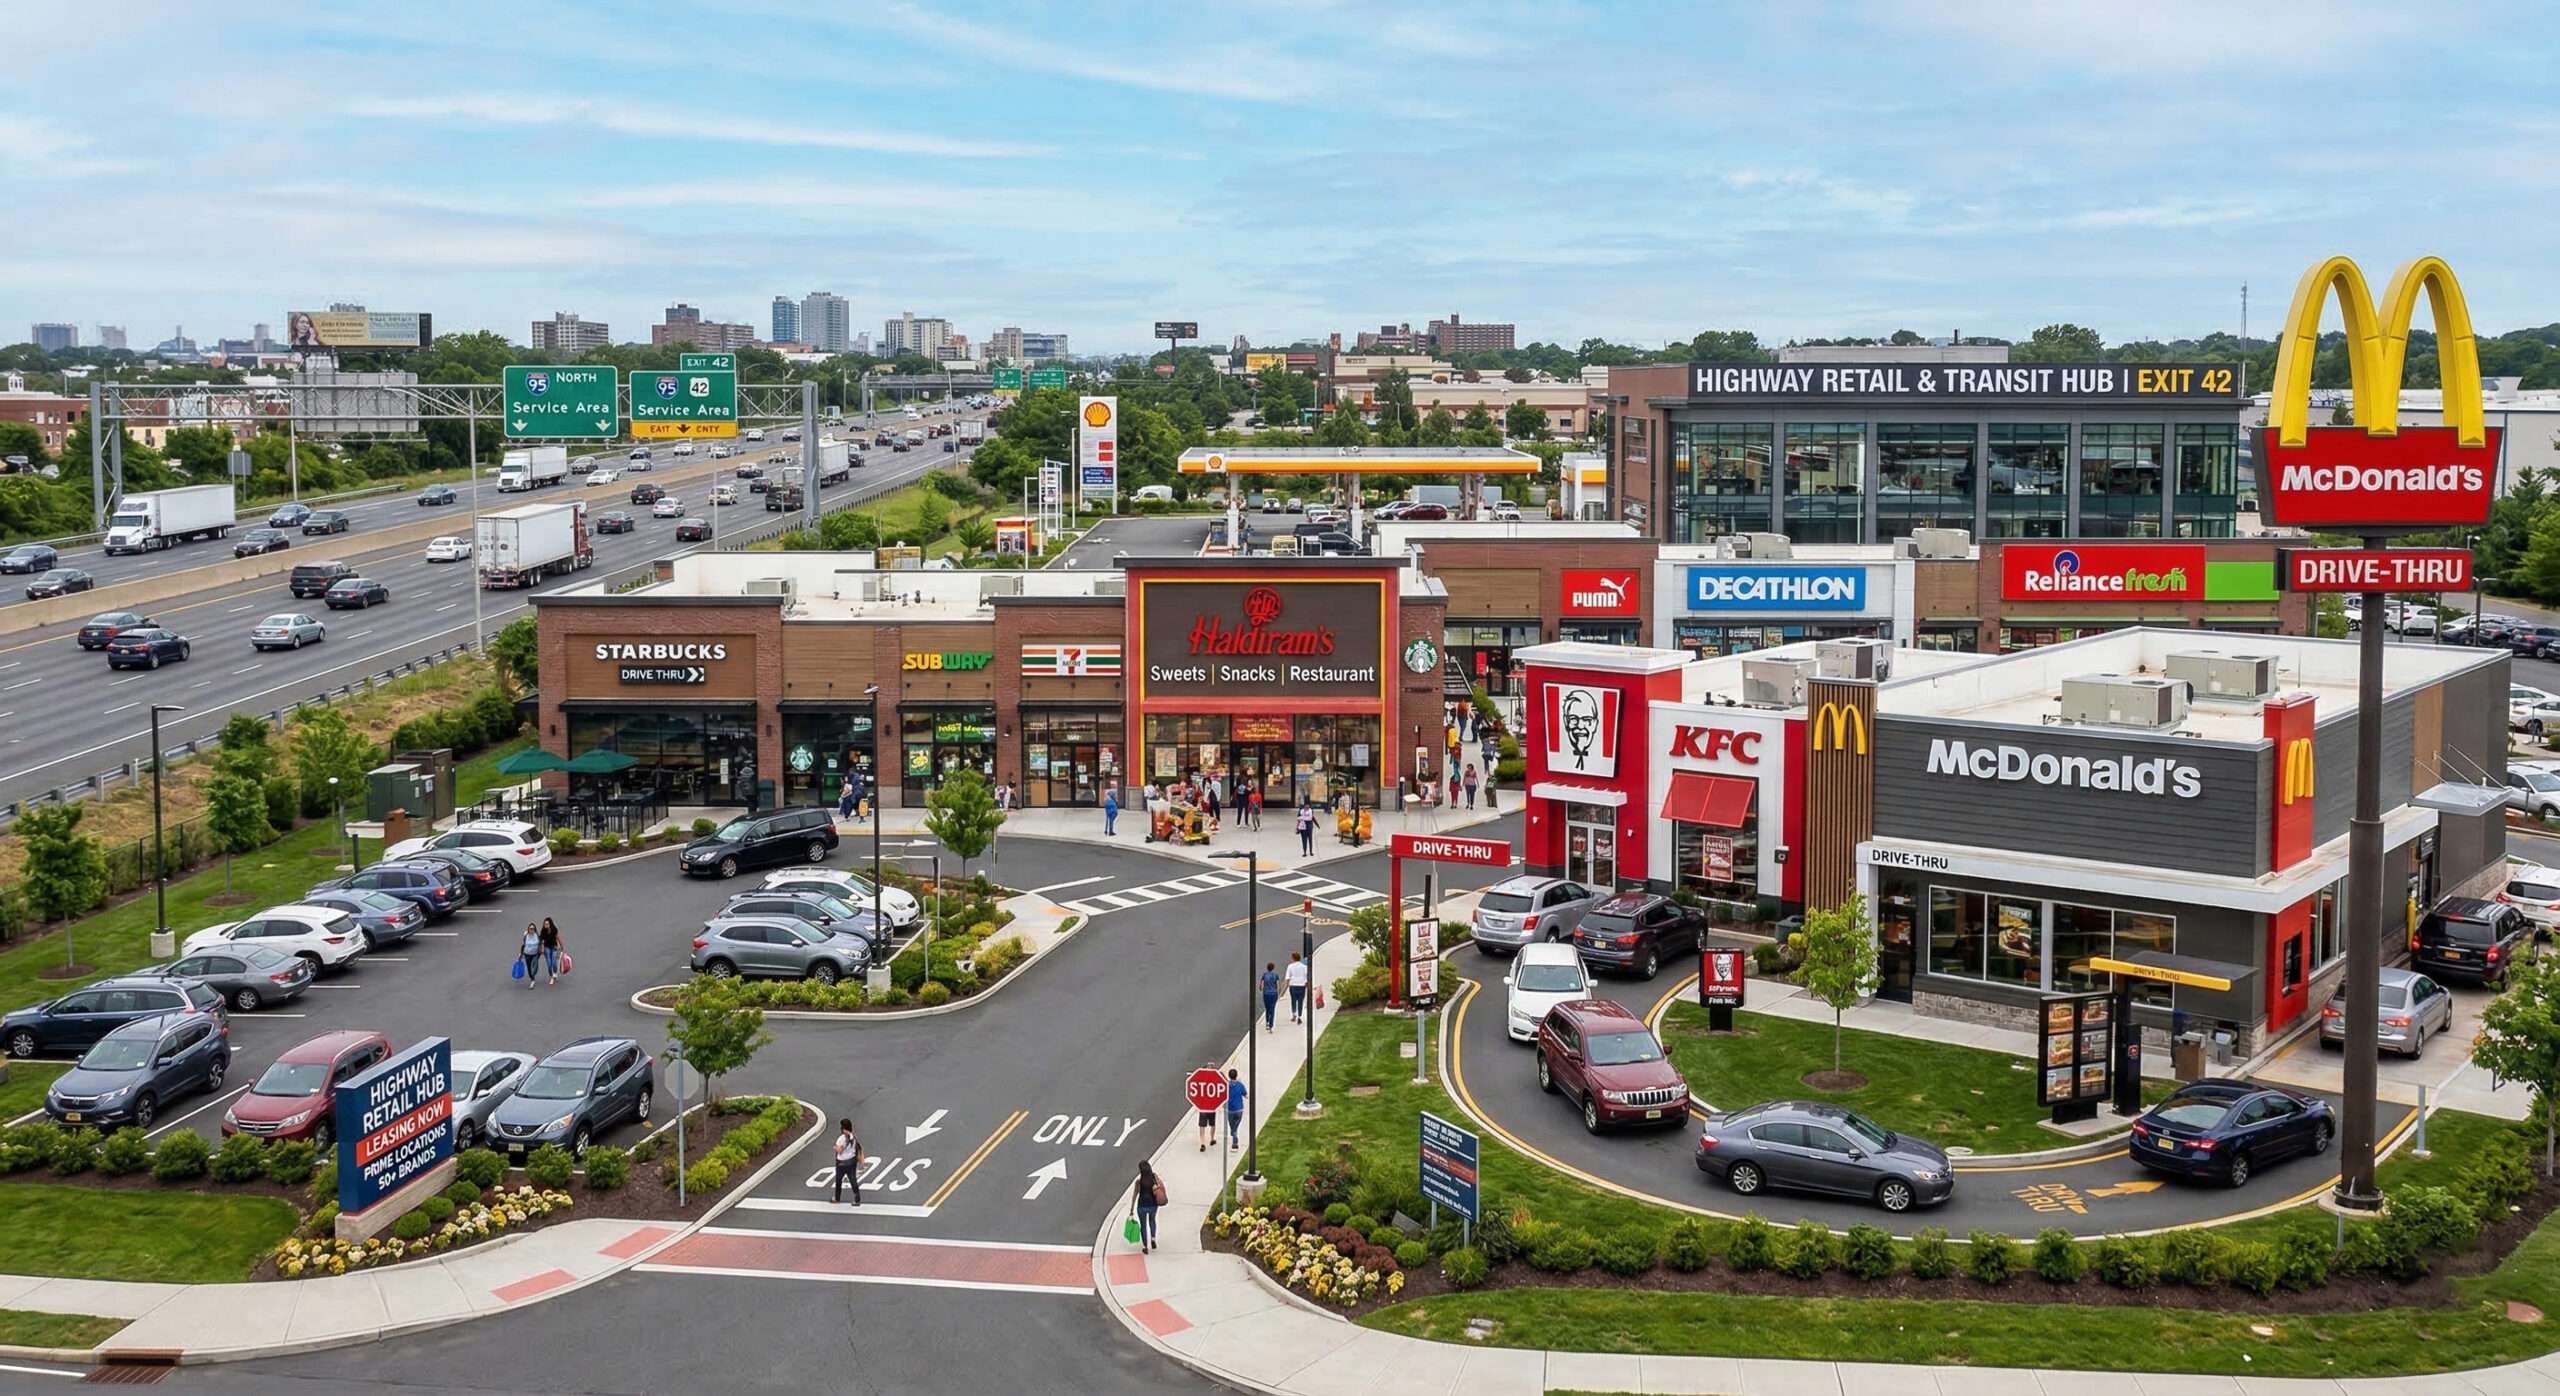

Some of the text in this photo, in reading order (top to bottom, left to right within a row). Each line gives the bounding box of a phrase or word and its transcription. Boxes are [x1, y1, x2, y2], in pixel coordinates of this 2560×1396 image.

[687, 357, 729, 367] EXIT 42
[528, 372, 597, 392] 95 NORTH
[658, 382, 708, 395] 95 42
[1696, 368, 2232, 394] HIGHWAY RETAIL & TRANSIT HUB EXIT 42
[512, 401, 609, 414] Service Area
[638, 404, 730, 416] Service Area
[2280, 463, 2484, 493] McDonald's
[2024, 567, 2187, 593] Reliance fresh
[2299, 558, 2464, 584] DRIVE-THRU
[1572, 592, 1617, 608] PUMA
[1698, 576, 1856, 602] DECATHLON
[1187, 612, 1337, 656] Haldiram's
[595, 643, 726, 660] STARBUCKS
[901, 651, 993, 671] SUBWAY
[621, 669, 686, 680] DRIVE THRU
[1150, 665, 1375, 682] Sweets Snacks Restaurant
[1669, 724, 1763, 765] KFC
[1927, 738, 2202, 798] McDonald's
[1411, 841, 1493, 861] DRIVE-THRU
[1871, 848, 1950, 870] DRIVE-THRU
[370, 1051, 438, 1107] HIGHWAY
[1188, 1080, 1227, 1099] STOP
[362, 1072, 445, 1134] RETAIL HUB
[365, 1099, 445, 1157] LEASING NOW
[1032, 1113, 1148, 1148] ONLY
[395, 1122, 447, 1163] LOCATIONS
[398, 1146, 437, 1179] BRANDS
